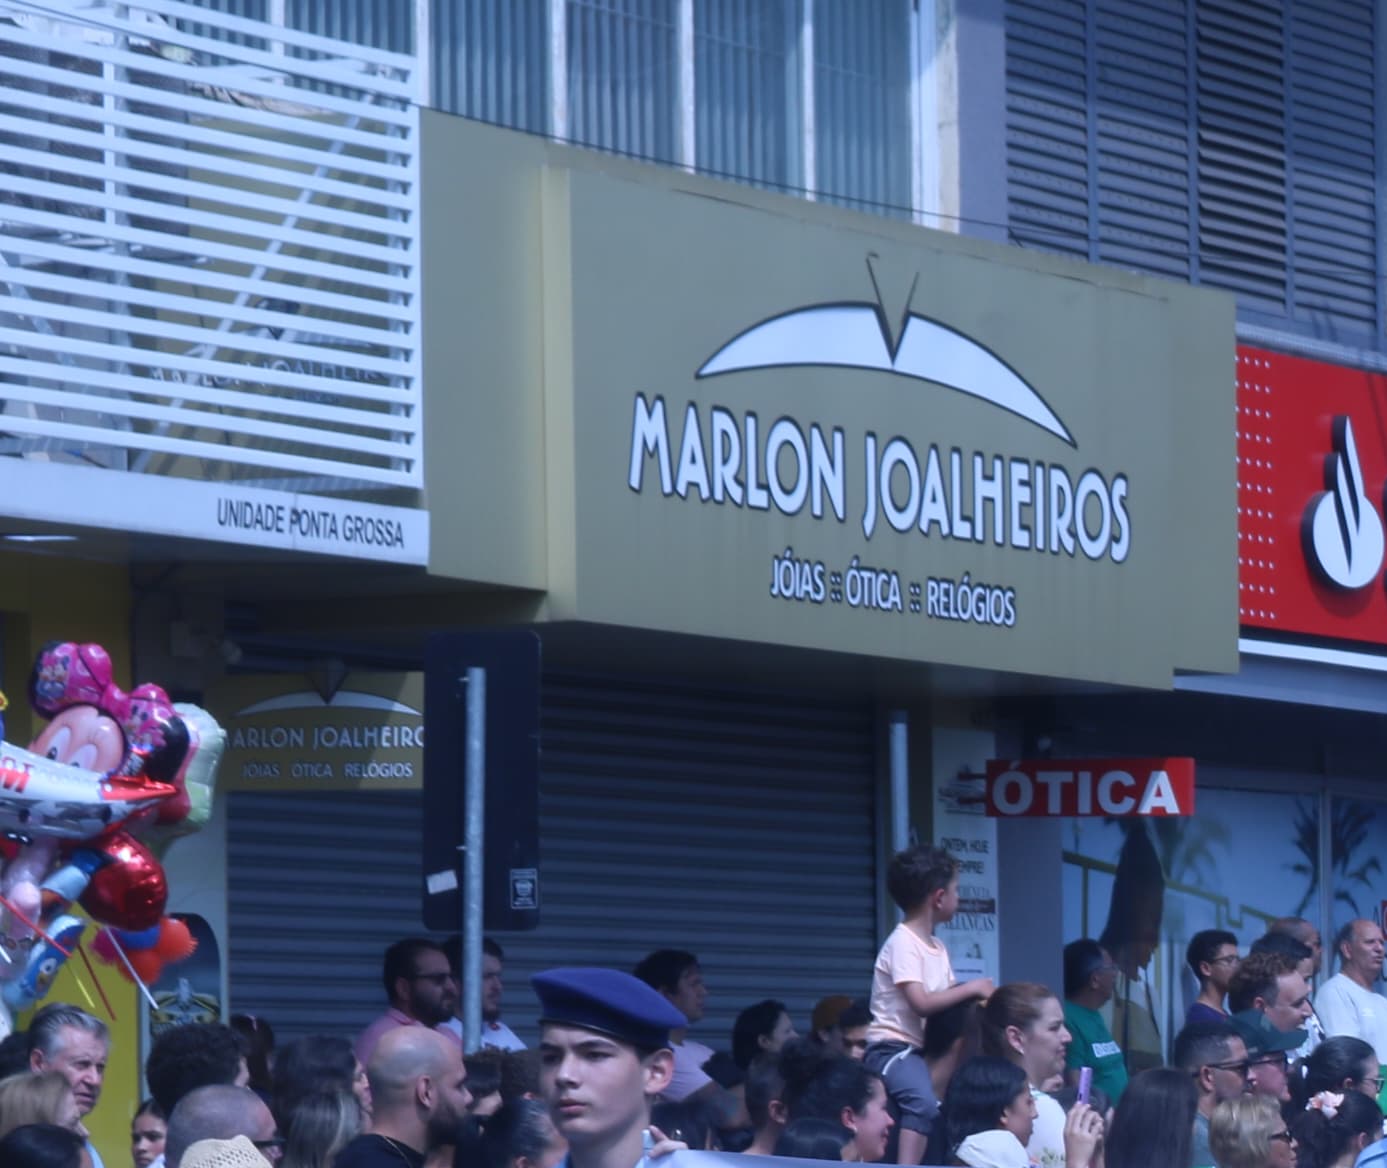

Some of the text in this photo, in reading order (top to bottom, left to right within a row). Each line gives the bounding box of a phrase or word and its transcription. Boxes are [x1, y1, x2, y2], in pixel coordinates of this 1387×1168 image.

[628, 391, 1131, 564] MARLON JOALHEIROS
[217, 497, 405, 549] UNIDADE PONTA GROSSA
[770, 545, 1016, 627] JÓIAS ÓTICA RELÓGIOS
[312, 725, 424, 750] JOALHEIRO
[242, 758, 413, 778] JÓIAS ÓTICA RELÓGIOS
[990, 761, 1180, 815] ÓTICA
